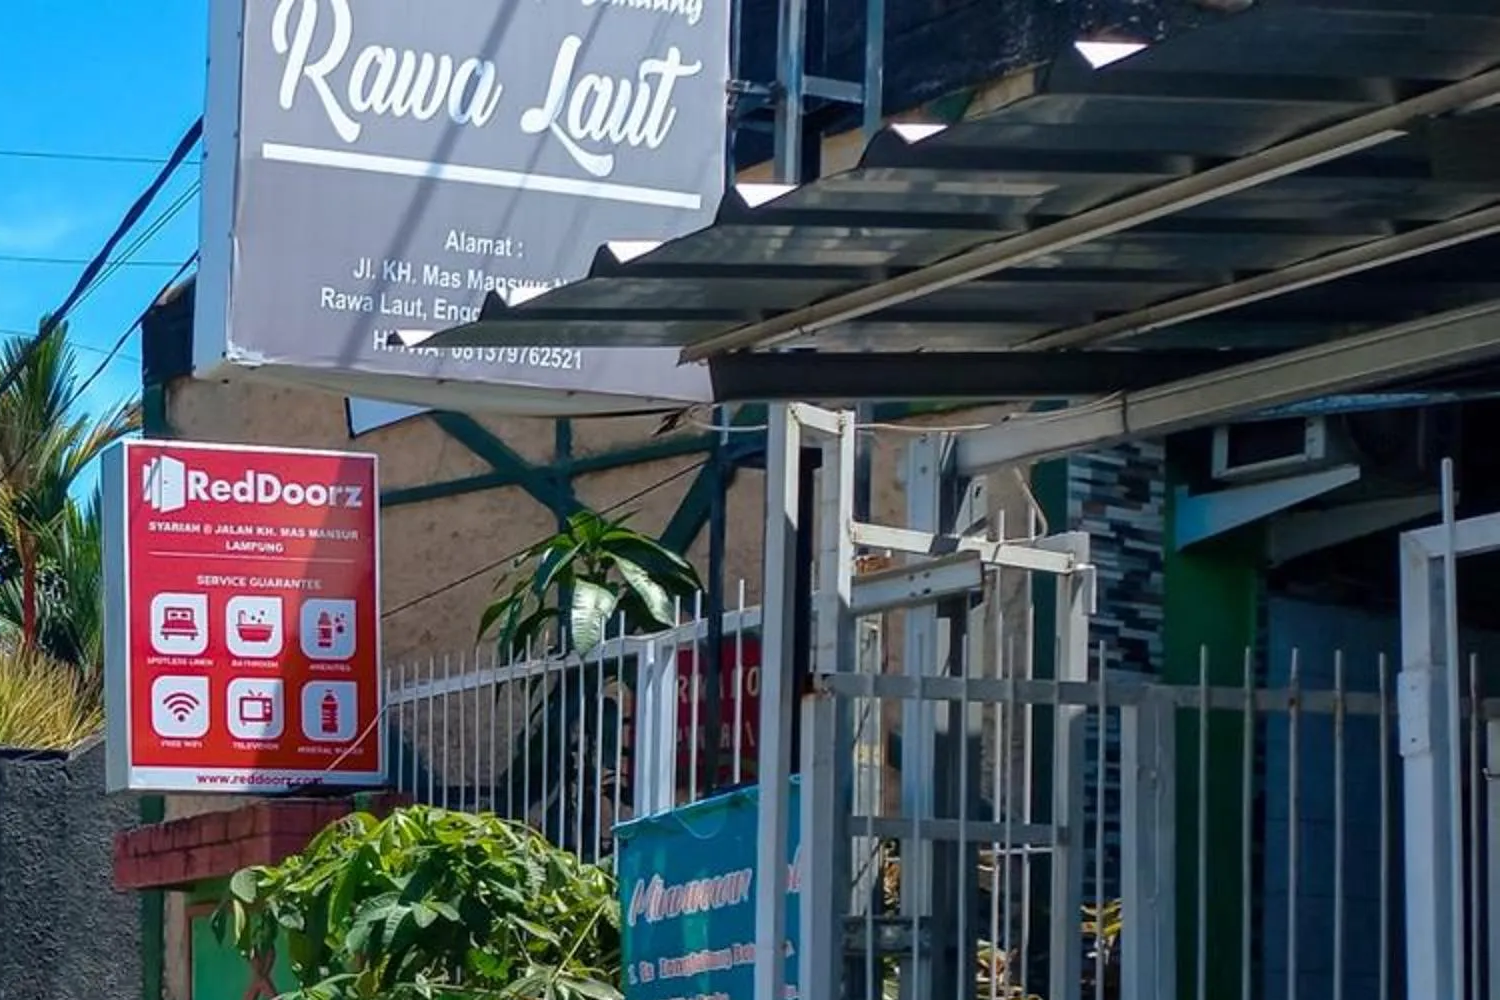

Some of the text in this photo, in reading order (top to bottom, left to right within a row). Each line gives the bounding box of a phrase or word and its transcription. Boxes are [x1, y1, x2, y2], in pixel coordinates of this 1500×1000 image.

[272, 0, 703, 177] Rawa Laut
[445, 230, 512, 257] Alamat
[353, 257, 376, 280] Jl.
[382, 259, 416, 283] KH.
[423, 264, 462, 288] Mas
[320, 287, 373, 312] Rawa
[380, 294, 427, 320] Laut,
[187, 470, 363, 508] RedDoorz
[148, 521, 200, 533] SYARIAH
[215, 524, 253, 535] JALAN
[256, 525, 277, 537] KH.
[280, 526, 305, 538] MAS
[226, 541, 285, 553] LAMPUNG
[197, 574, 322, 590] SERVICE GUARANTEE
